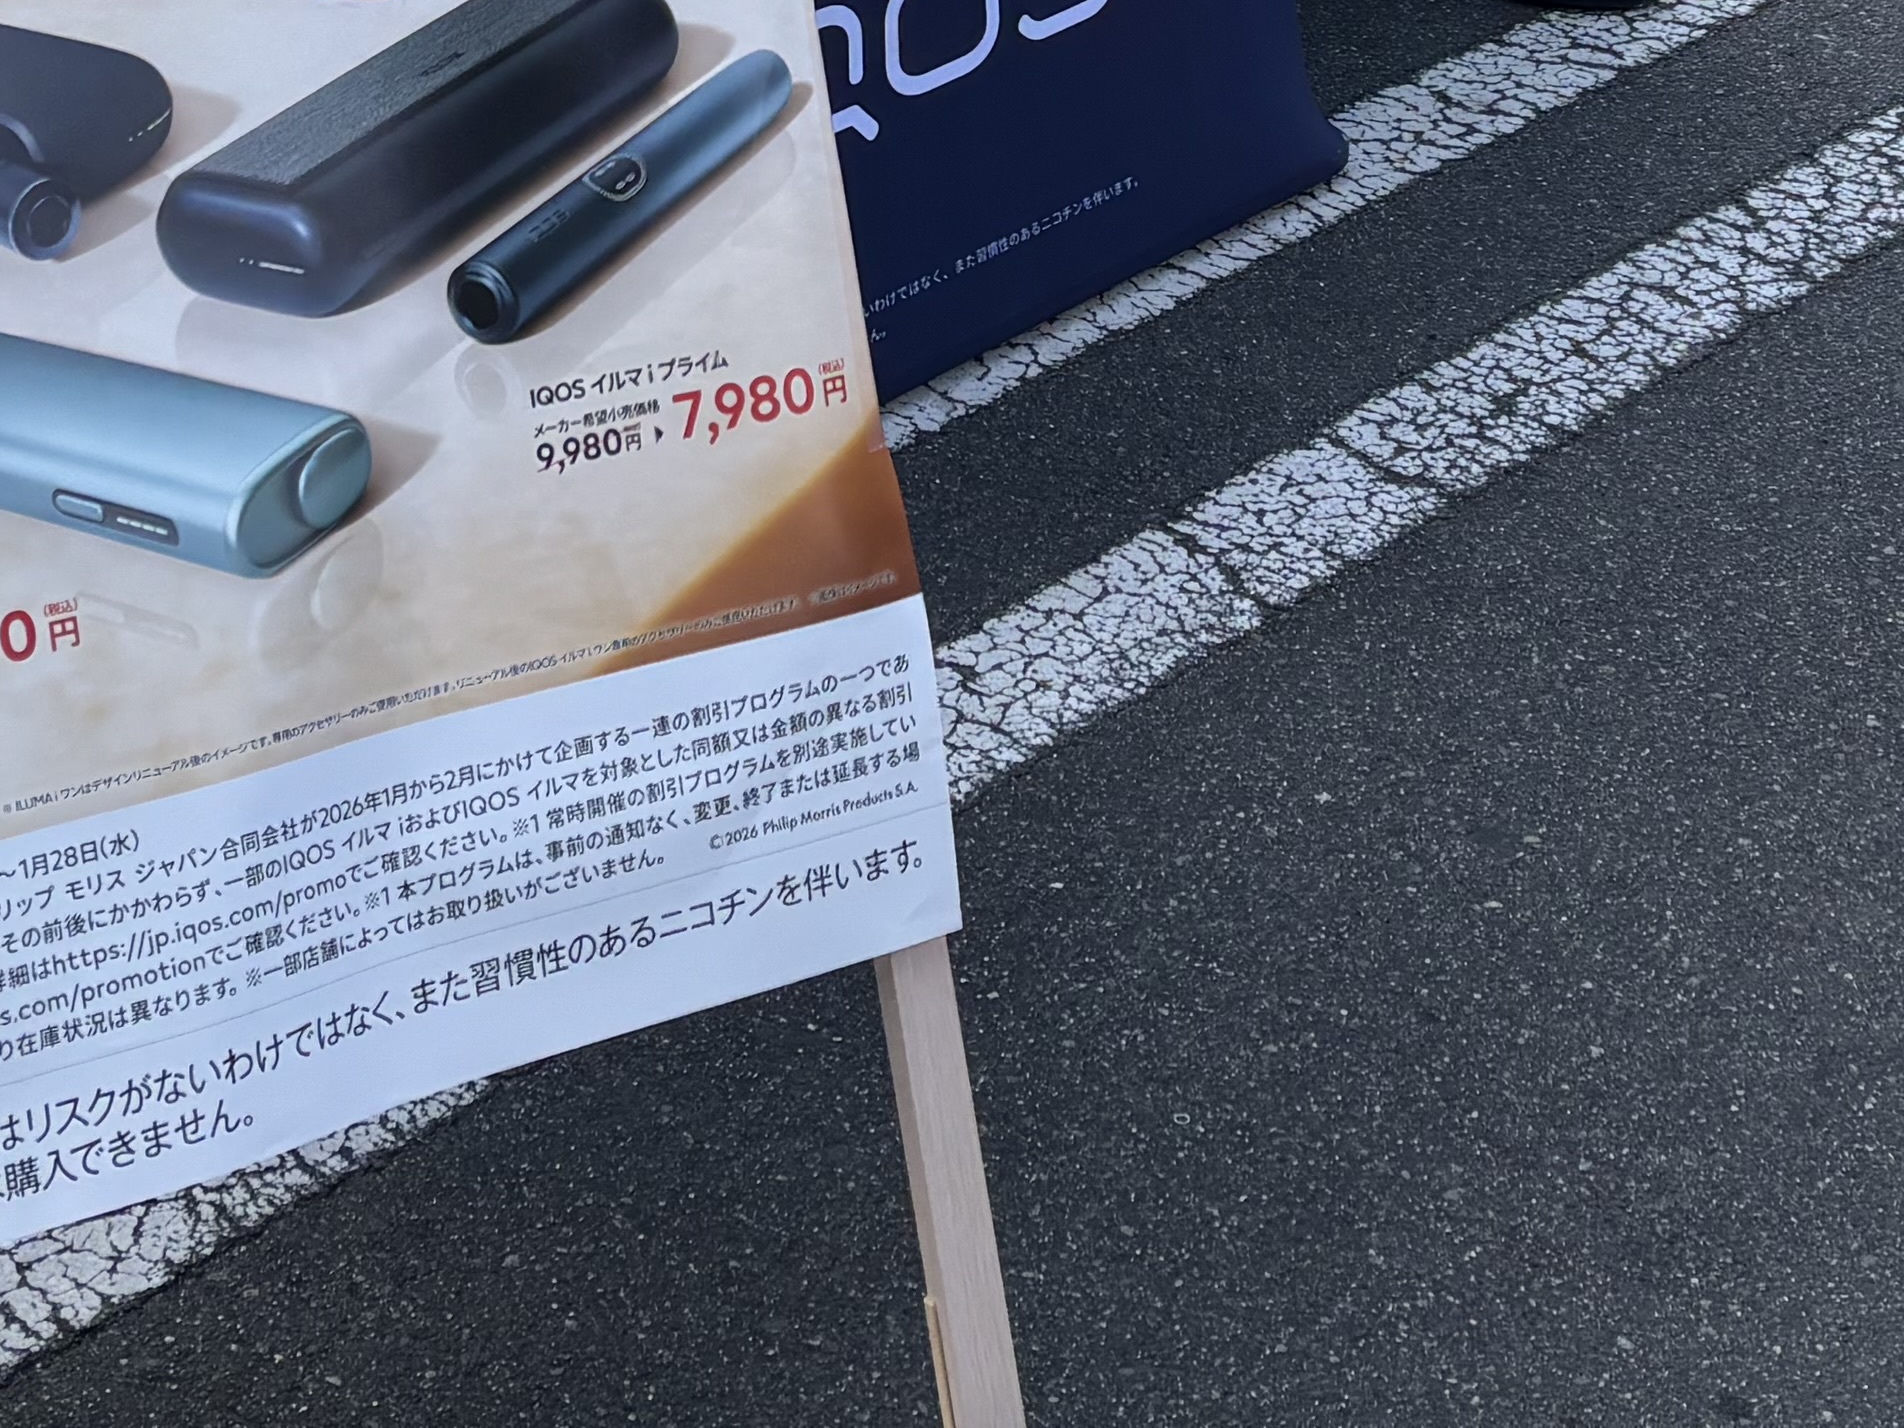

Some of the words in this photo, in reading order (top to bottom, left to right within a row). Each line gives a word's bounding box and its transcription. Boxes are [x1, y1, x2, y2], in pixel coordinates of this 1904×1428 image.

[529, 378, 586, 409] IQOS
[658, 349, 729, 381] プライム
[534, 400, 660, 439] メーカー希望小売価格
[672, 368, 848, 445] 7,980円
[763, 815, 797, 834] Philip
[800, 803, 841, 826] Morris
[843, 791, 892, 814] Products
[66, 870, 125, 901] モリス
